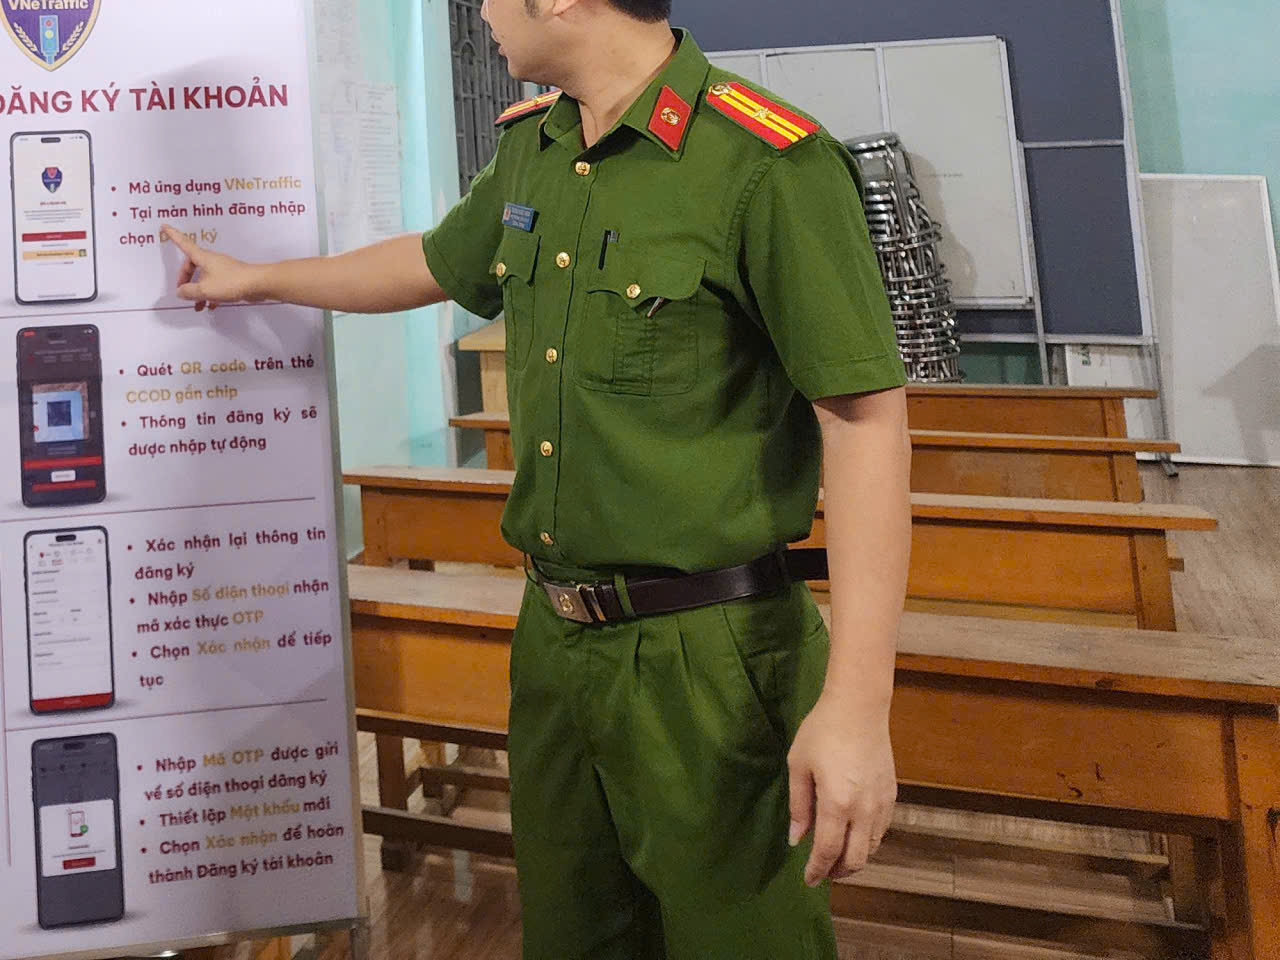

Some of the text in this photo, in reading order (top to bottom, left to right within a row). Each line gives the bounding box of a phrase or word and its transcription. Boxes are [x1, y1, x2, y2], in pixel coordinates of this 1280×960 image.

[82, 83, 120, 112] KÝ
[130, 81, 175, 111] TÀI
[184, 77, 288, 109] KHOẢN
[186, 180, 221, 195] dụng
[224, 176, 301, 191] VNeTraffic
[130, 207, 151, 222] Tại
[270, 201, 305, 217] nhập
[120, 233, 154, 247] chọn
[138, 362, 172, 376] Quét
[210, 359, 247, 373] code
[254, 357, 283, 370] trên
[206, 385, 238, 400] chip
[197, 412, 215, 425] tin
[170, 436, 266, 455] nhập tự động
[146, 527, 325, 552] Xác nhận lại thông tin
[148, 591, 187, 606] Nhập
[294, 579, 329, 594] nhận
[195, 615, 229, 631] thực
[233, 610, 264, 625] OTP
[151, 645, 190, 660] Chọn
[140, 675, 163, 690] tục
[156, 757, 196, 773] Nhập
[225, 776, 264, 795] thoại
[160, 840, 200, 856] Chọn
